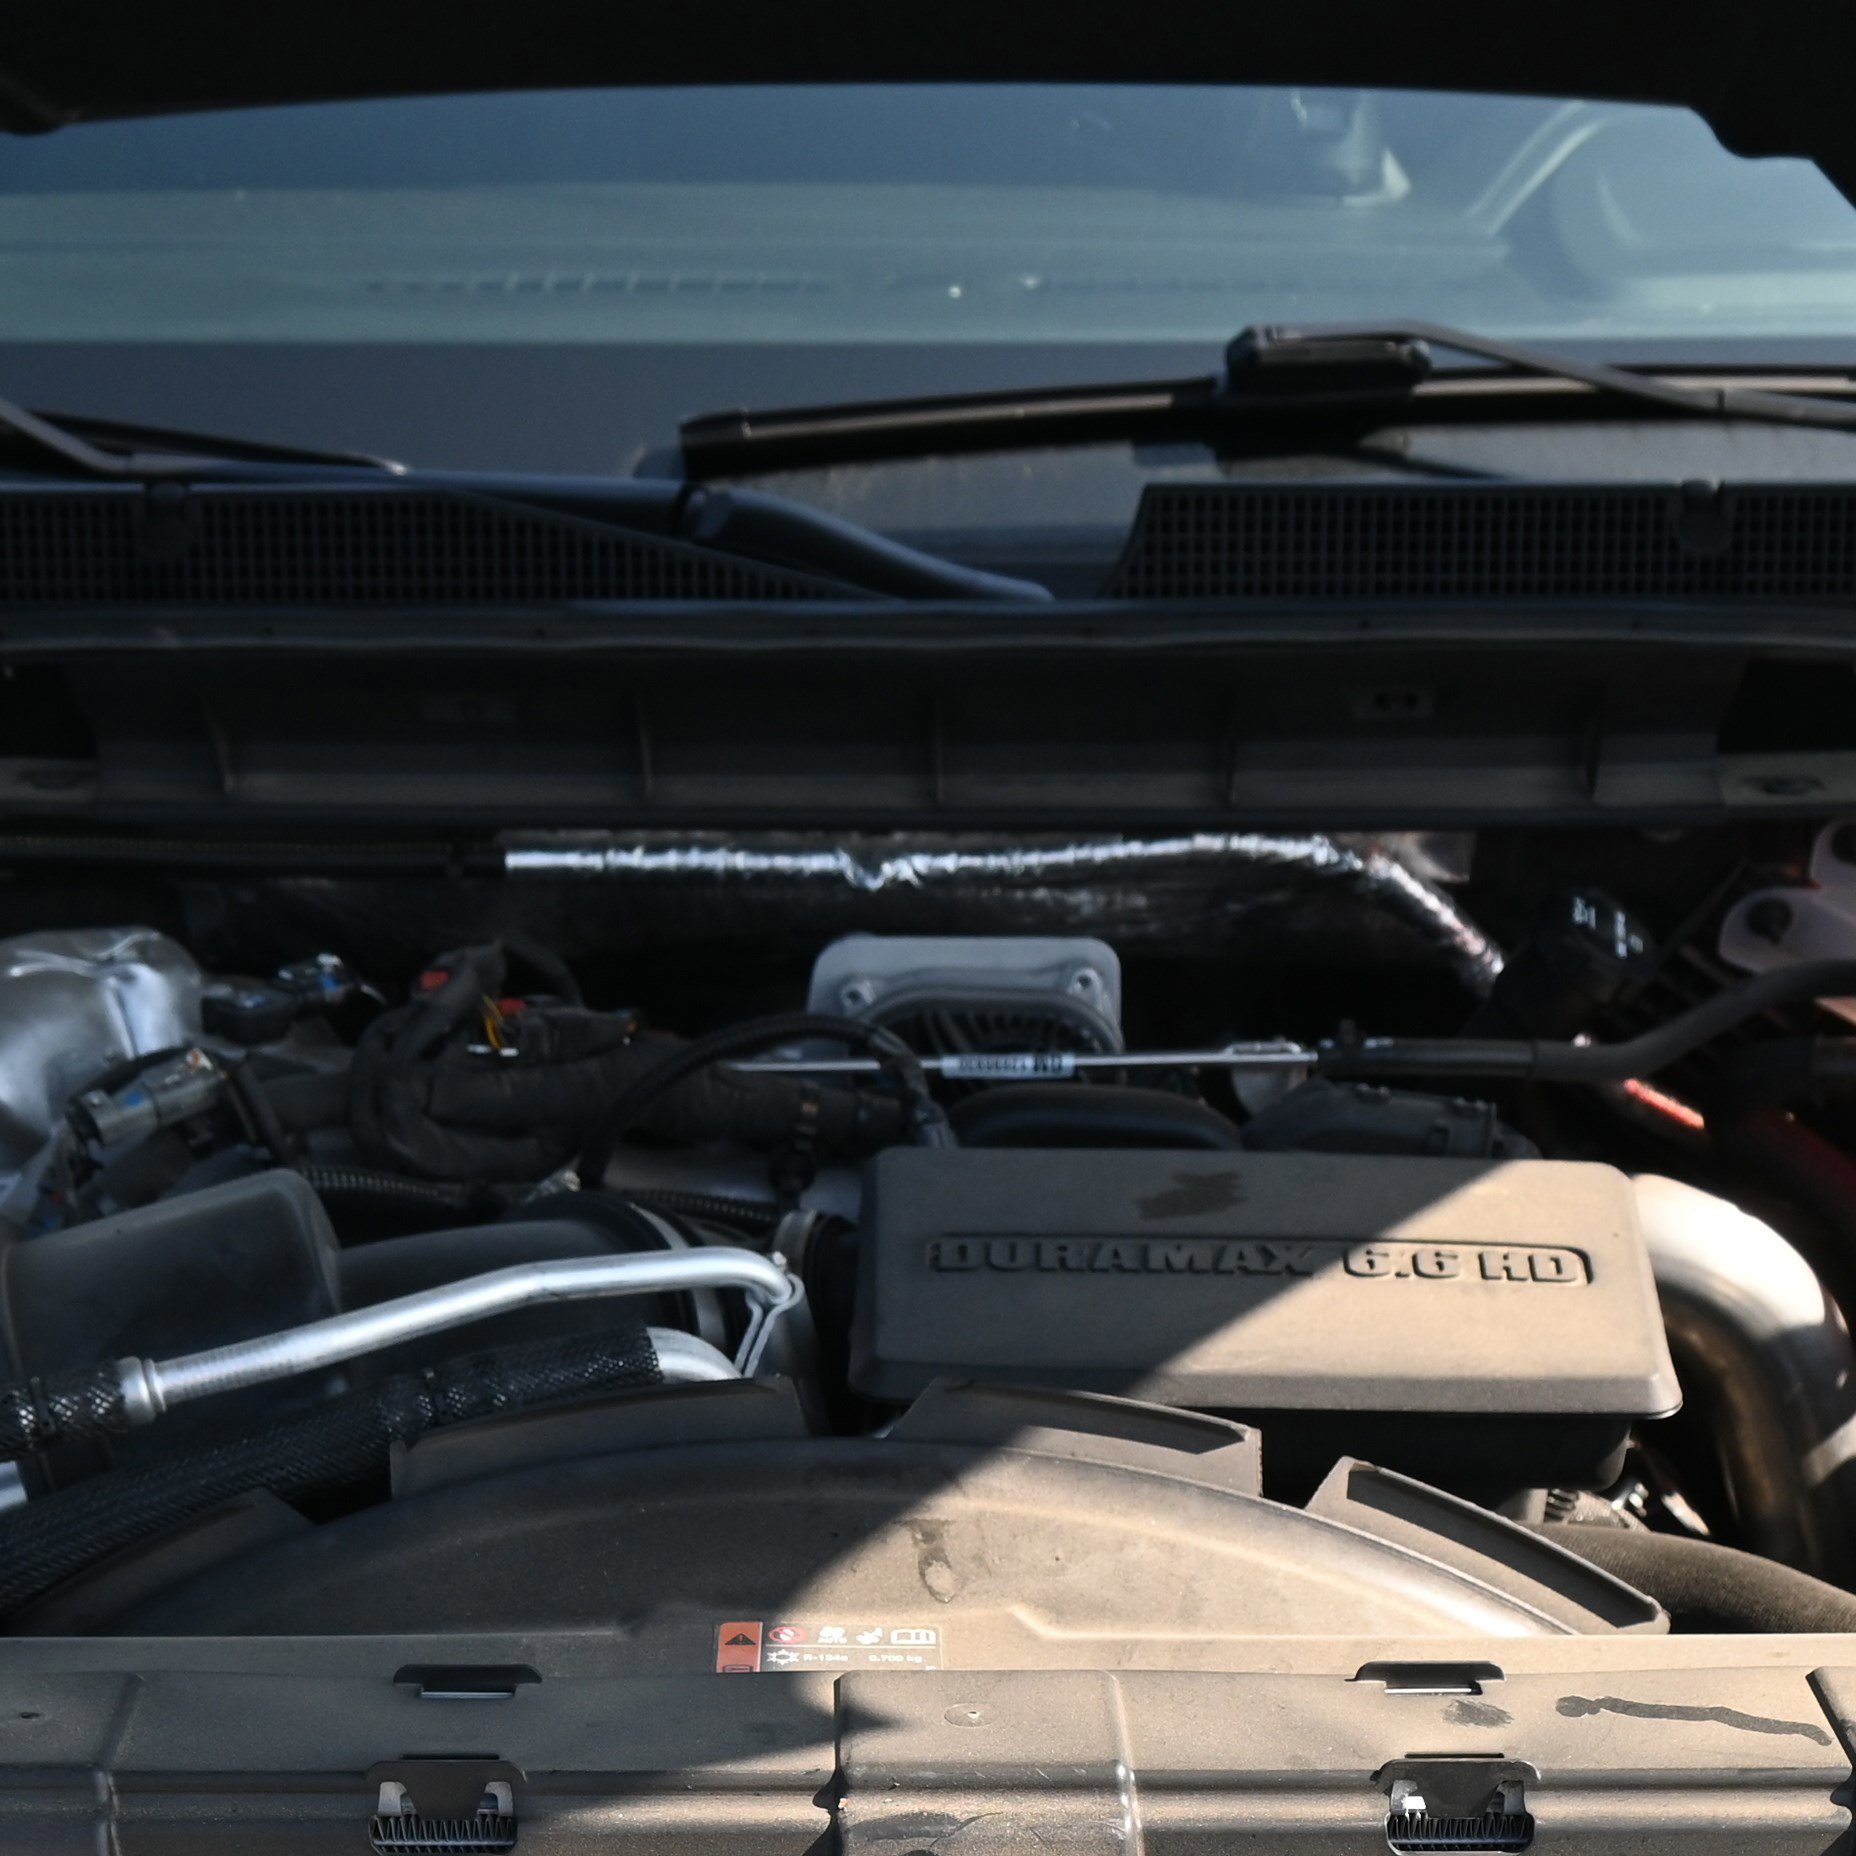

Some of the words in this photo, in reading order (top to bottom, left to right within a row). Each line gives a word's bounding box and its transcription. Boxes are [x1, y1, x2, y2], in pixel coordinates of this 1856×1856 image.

[931, 1237, 1313, 1277] DURAMAX
[1343, 1246, 1459, 1278] 6.6
[1478, 1249, 1578, 1282] HD
